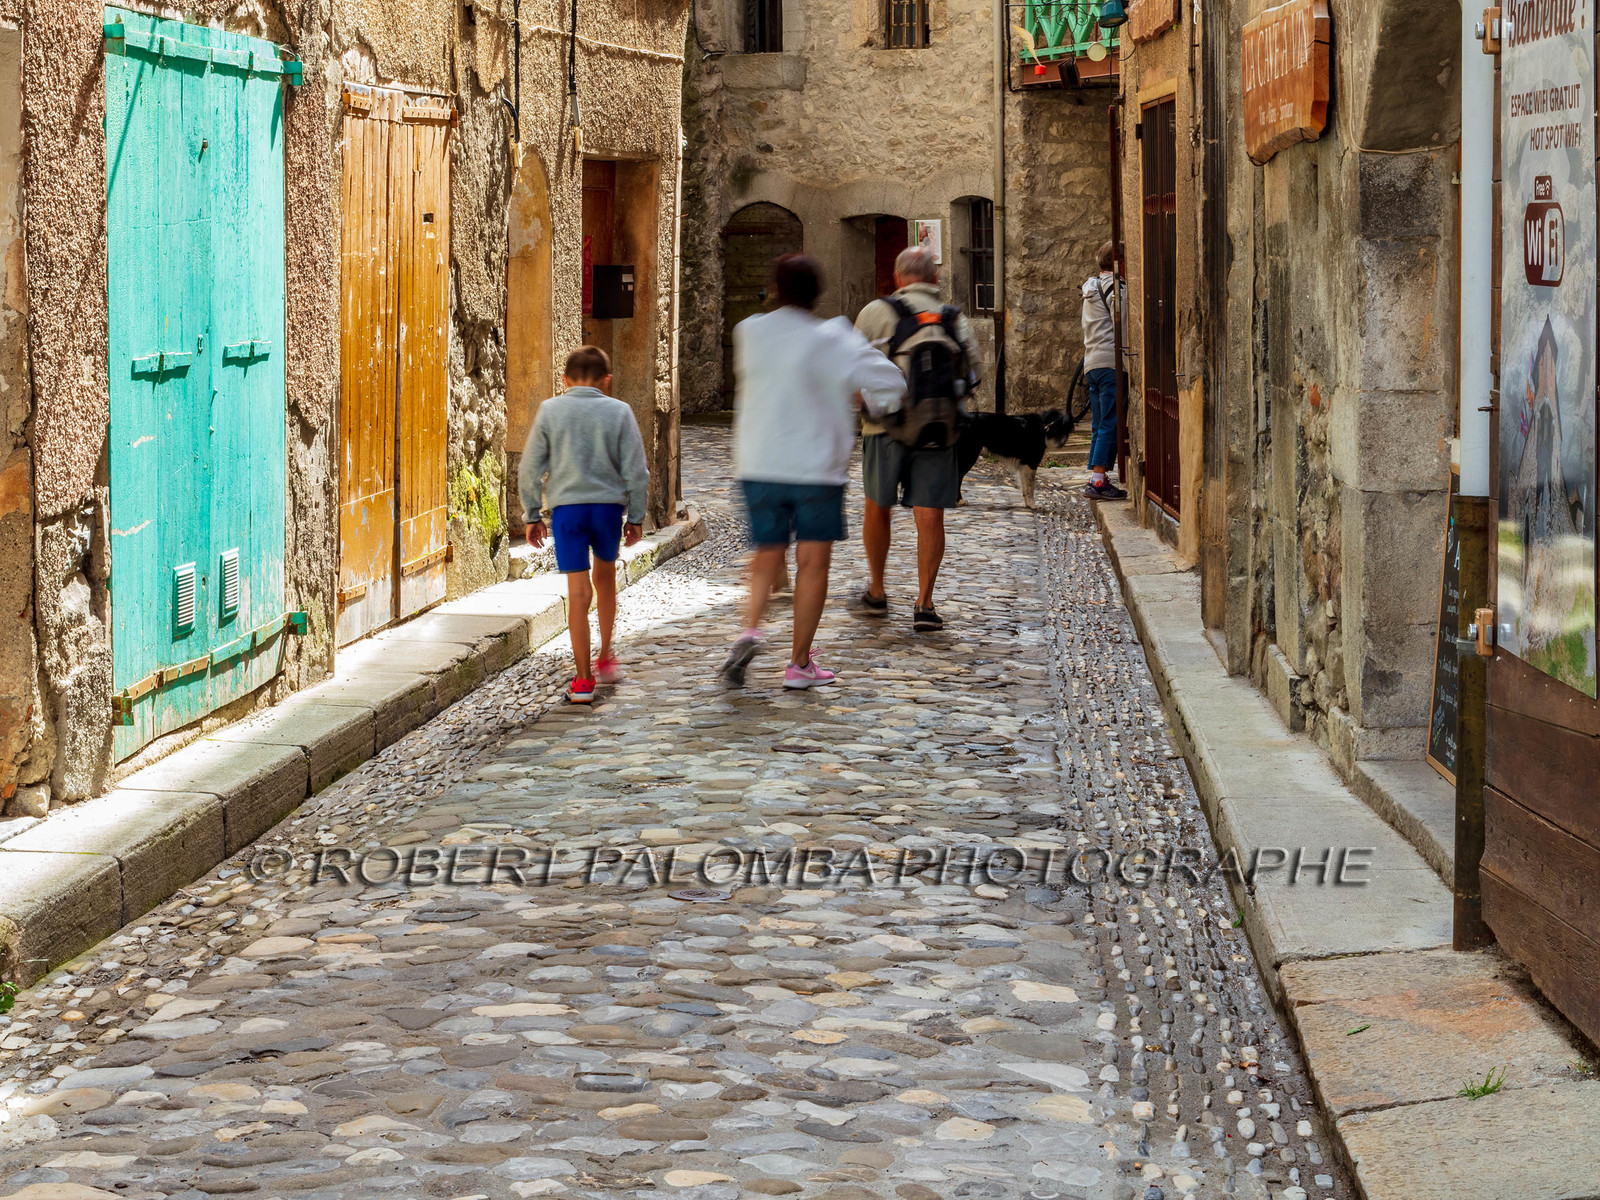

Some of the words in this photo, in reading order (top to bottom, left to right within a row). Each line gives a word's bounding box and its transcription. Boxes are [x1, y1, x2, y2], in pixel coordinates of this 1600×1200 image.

[1244, 36, 1256, 92] LA
[1258, 21, 1280, 87] CAVE
[1281, 17, 1288, 77] A
[1291, 5, 1312, 71] VIN
[1510, 91, 1533, 118] ESPACE
[1533, 88, 1548, 114] WIFI
[1549, 83, 1581, 112] GRATUIT
[1529, 127, 1545, 151] HOT
[1545, 124, 1564, 150] SPOT
[1564, 122, 1582, 148] WIFI
[1535, 180, 1546, 197] Free
